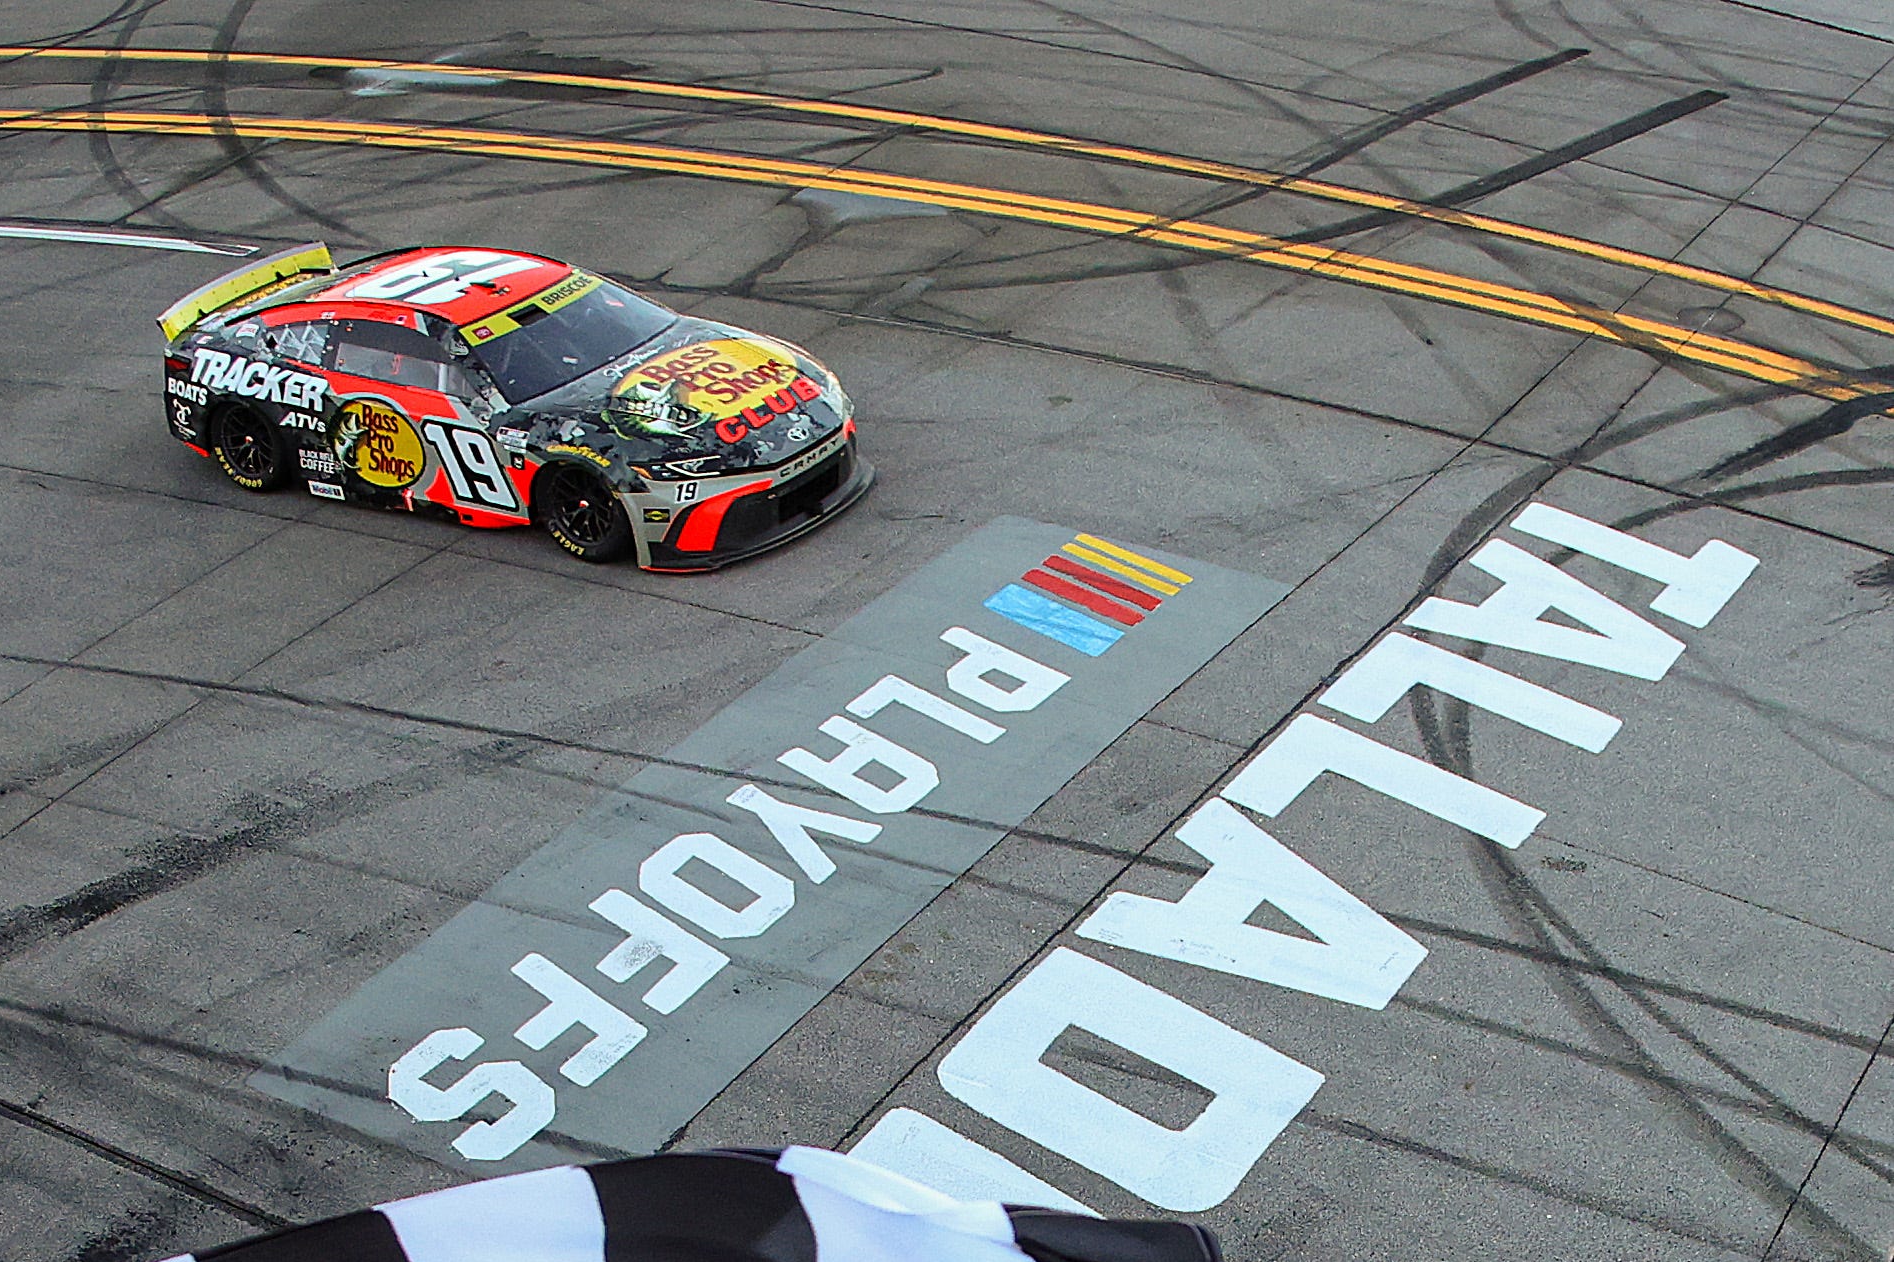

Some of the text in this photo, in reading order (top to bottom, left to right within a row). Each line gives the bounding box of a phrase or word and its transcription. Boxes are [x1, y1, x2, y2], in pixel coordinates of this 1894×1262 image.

[541, 274, 592, 306] BRISCOE
[190, 347, 329, 412] TRACKER
[638, 345, 721, 384] Bass
[679, 360, 738, 393] Pro
[705, 357, 794, 405] Shops
[168, 376, 208, 406] BOATS
[279, 411, 327, 433] ATVs
[362, 403, 399, 433] Bass
[714, 376, 824, 444] CLUB
[367, 428, 395, 453] Pro
[300, 458, 335, 474] COFFEE
[369, 447, 416, 483] Shops
[421, 421, 520, 511] 19
[675, 480, 700, 504] 19
[846, 501, 1760, 1220] TALLAD
[387, 625, 1072, 1162] PLAYOFFS
